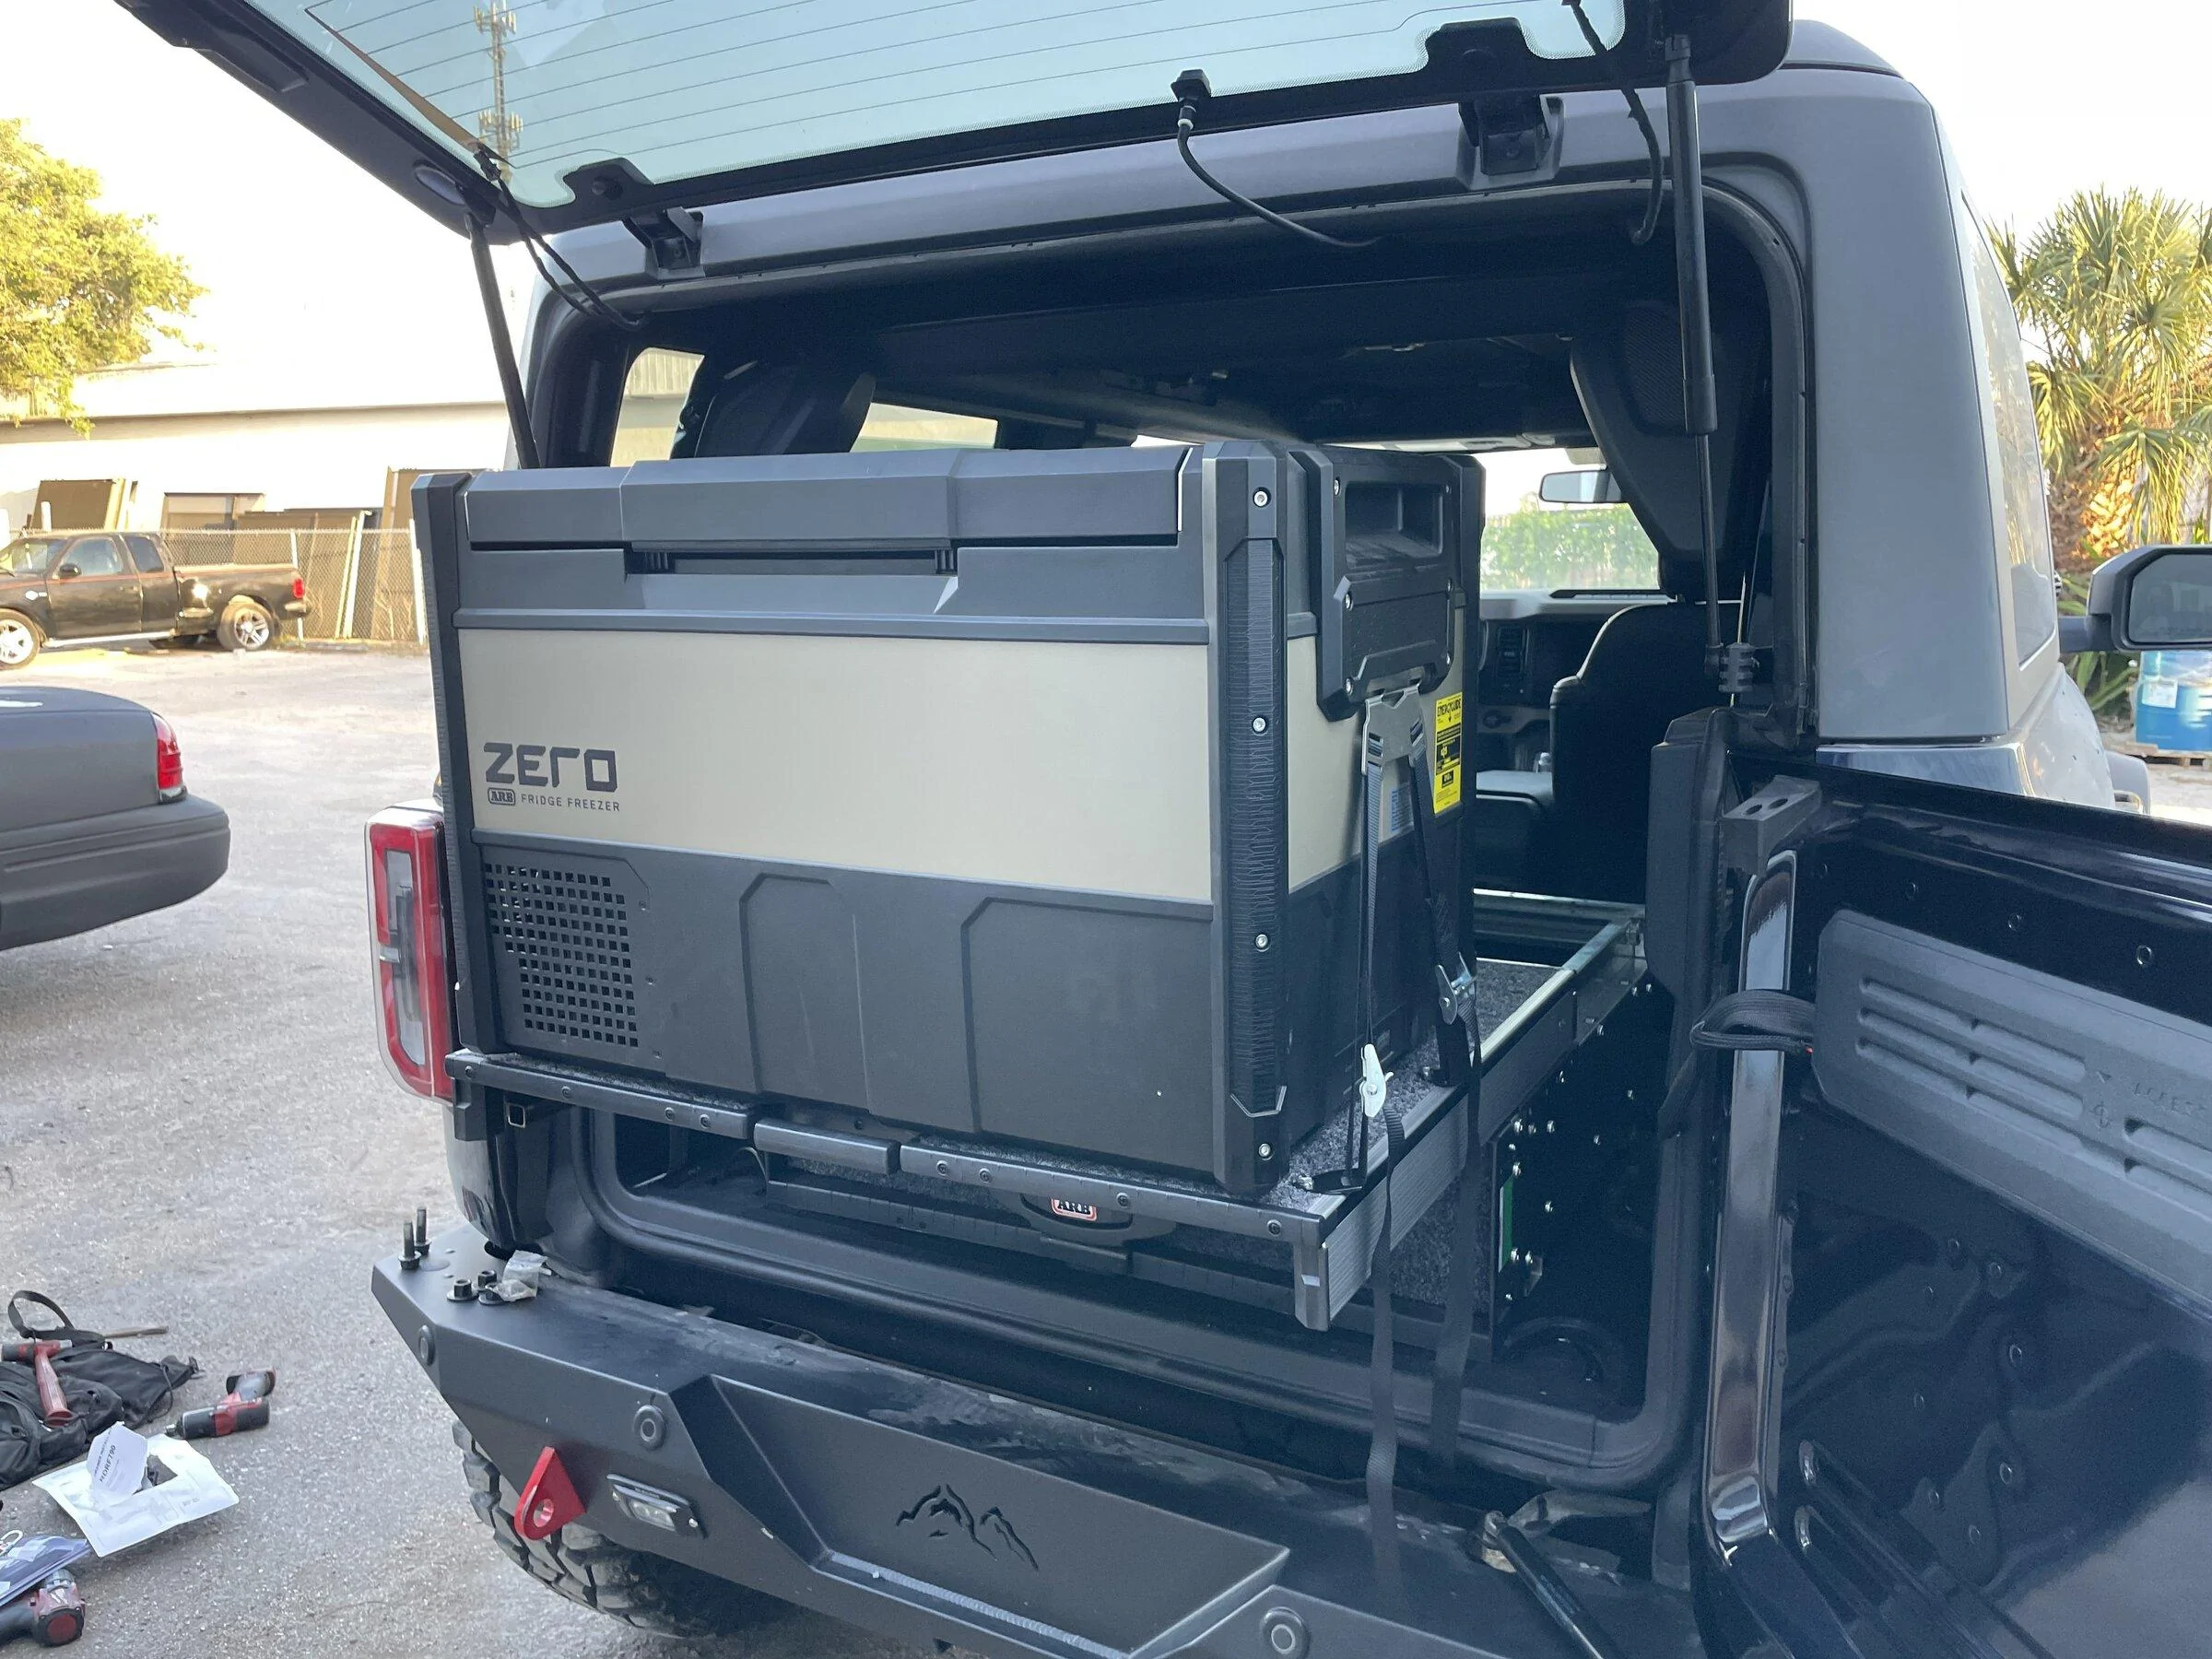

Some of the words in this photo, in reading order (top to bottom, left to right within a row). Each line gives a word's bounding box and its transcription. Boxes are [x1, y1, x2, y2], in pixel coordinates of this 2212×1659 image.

[490, 790, 514, 804] ARB
[521, 794, 562, 806] FRIDGE
[567, 798, 620, 811] FREEZER
[1057, 1200, 1091, 1215] ARB
